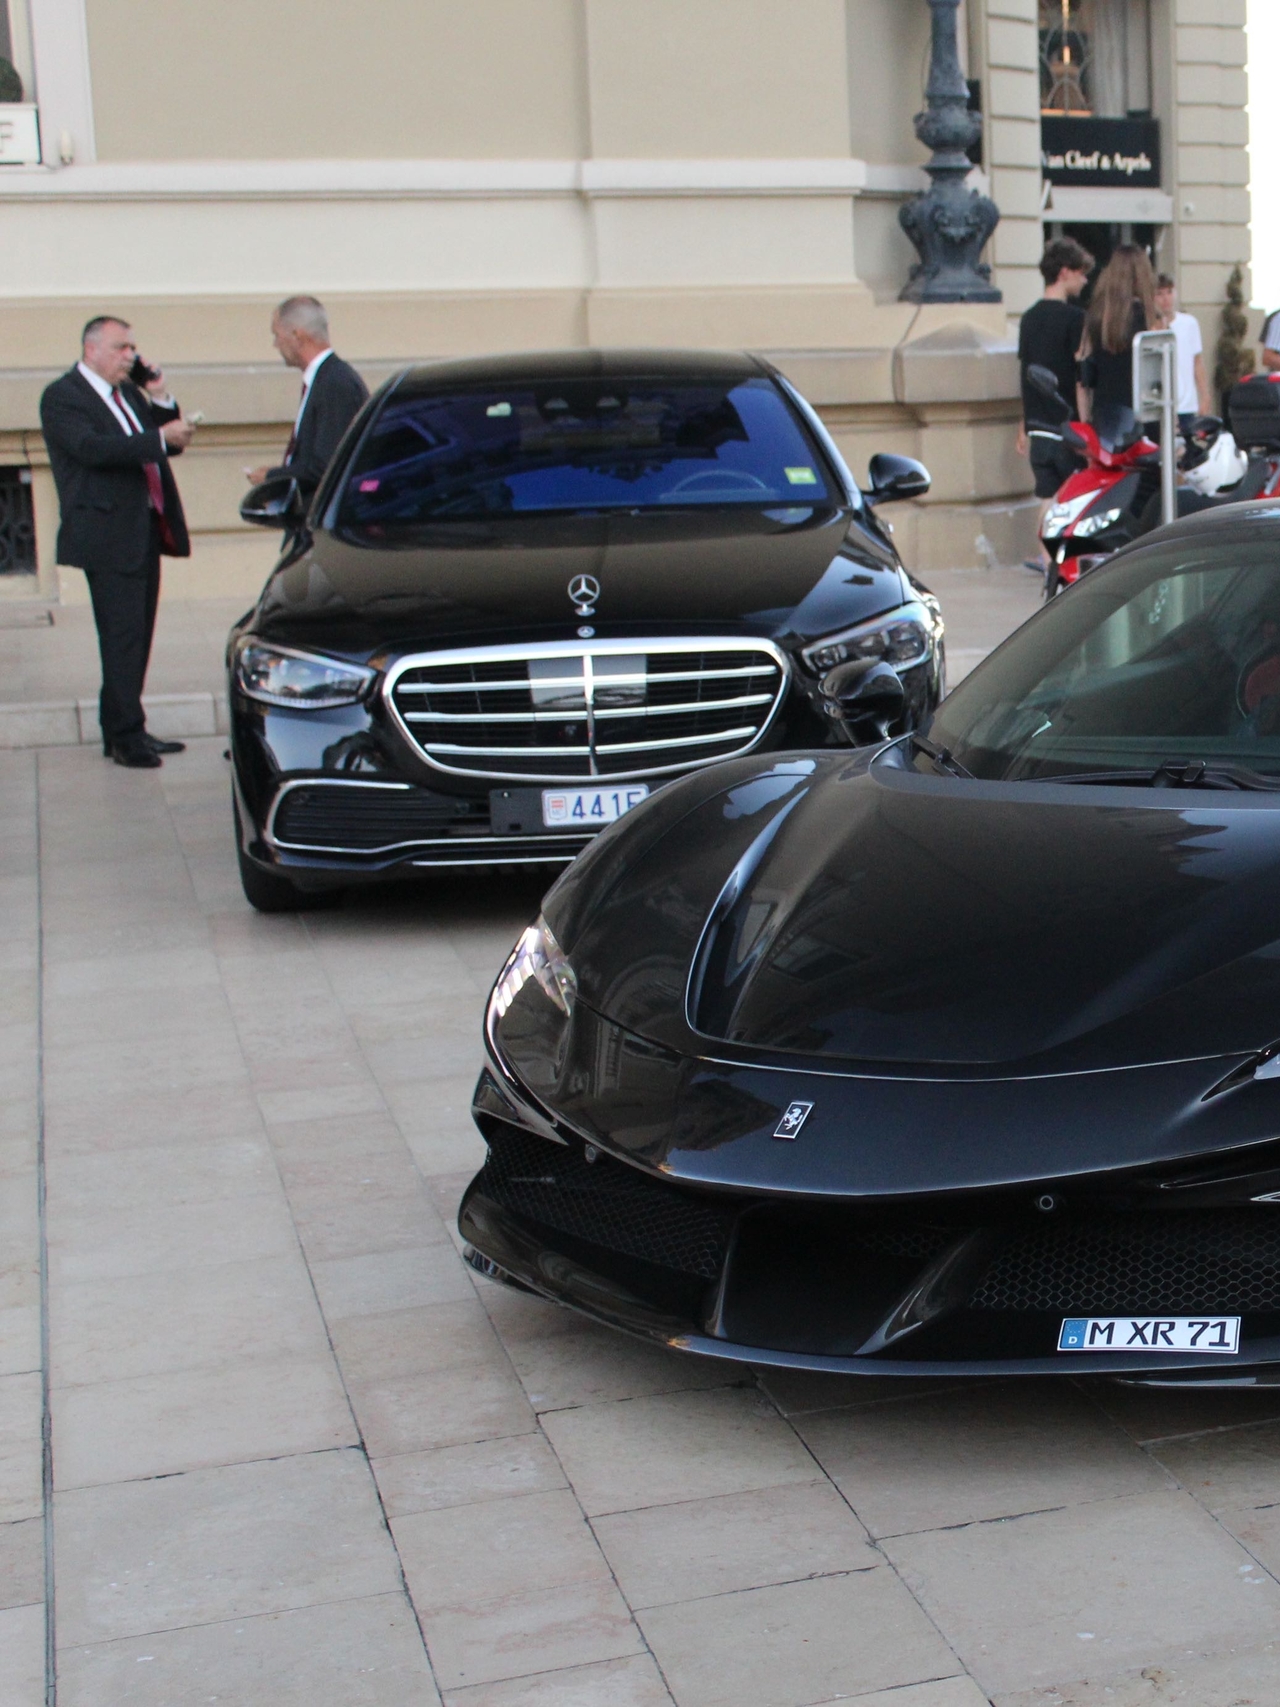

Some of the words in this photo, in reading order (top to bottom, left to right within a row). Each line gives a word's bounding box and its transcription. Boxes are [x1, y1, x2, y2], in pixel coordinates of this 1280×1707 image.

[1068, 1336, 1078, 1344] D
[1089, 1321, 1115, 1345] M
[1126, 1321, 1176, 1346] XR
[1188, 1321, 1230, 1347] 71
